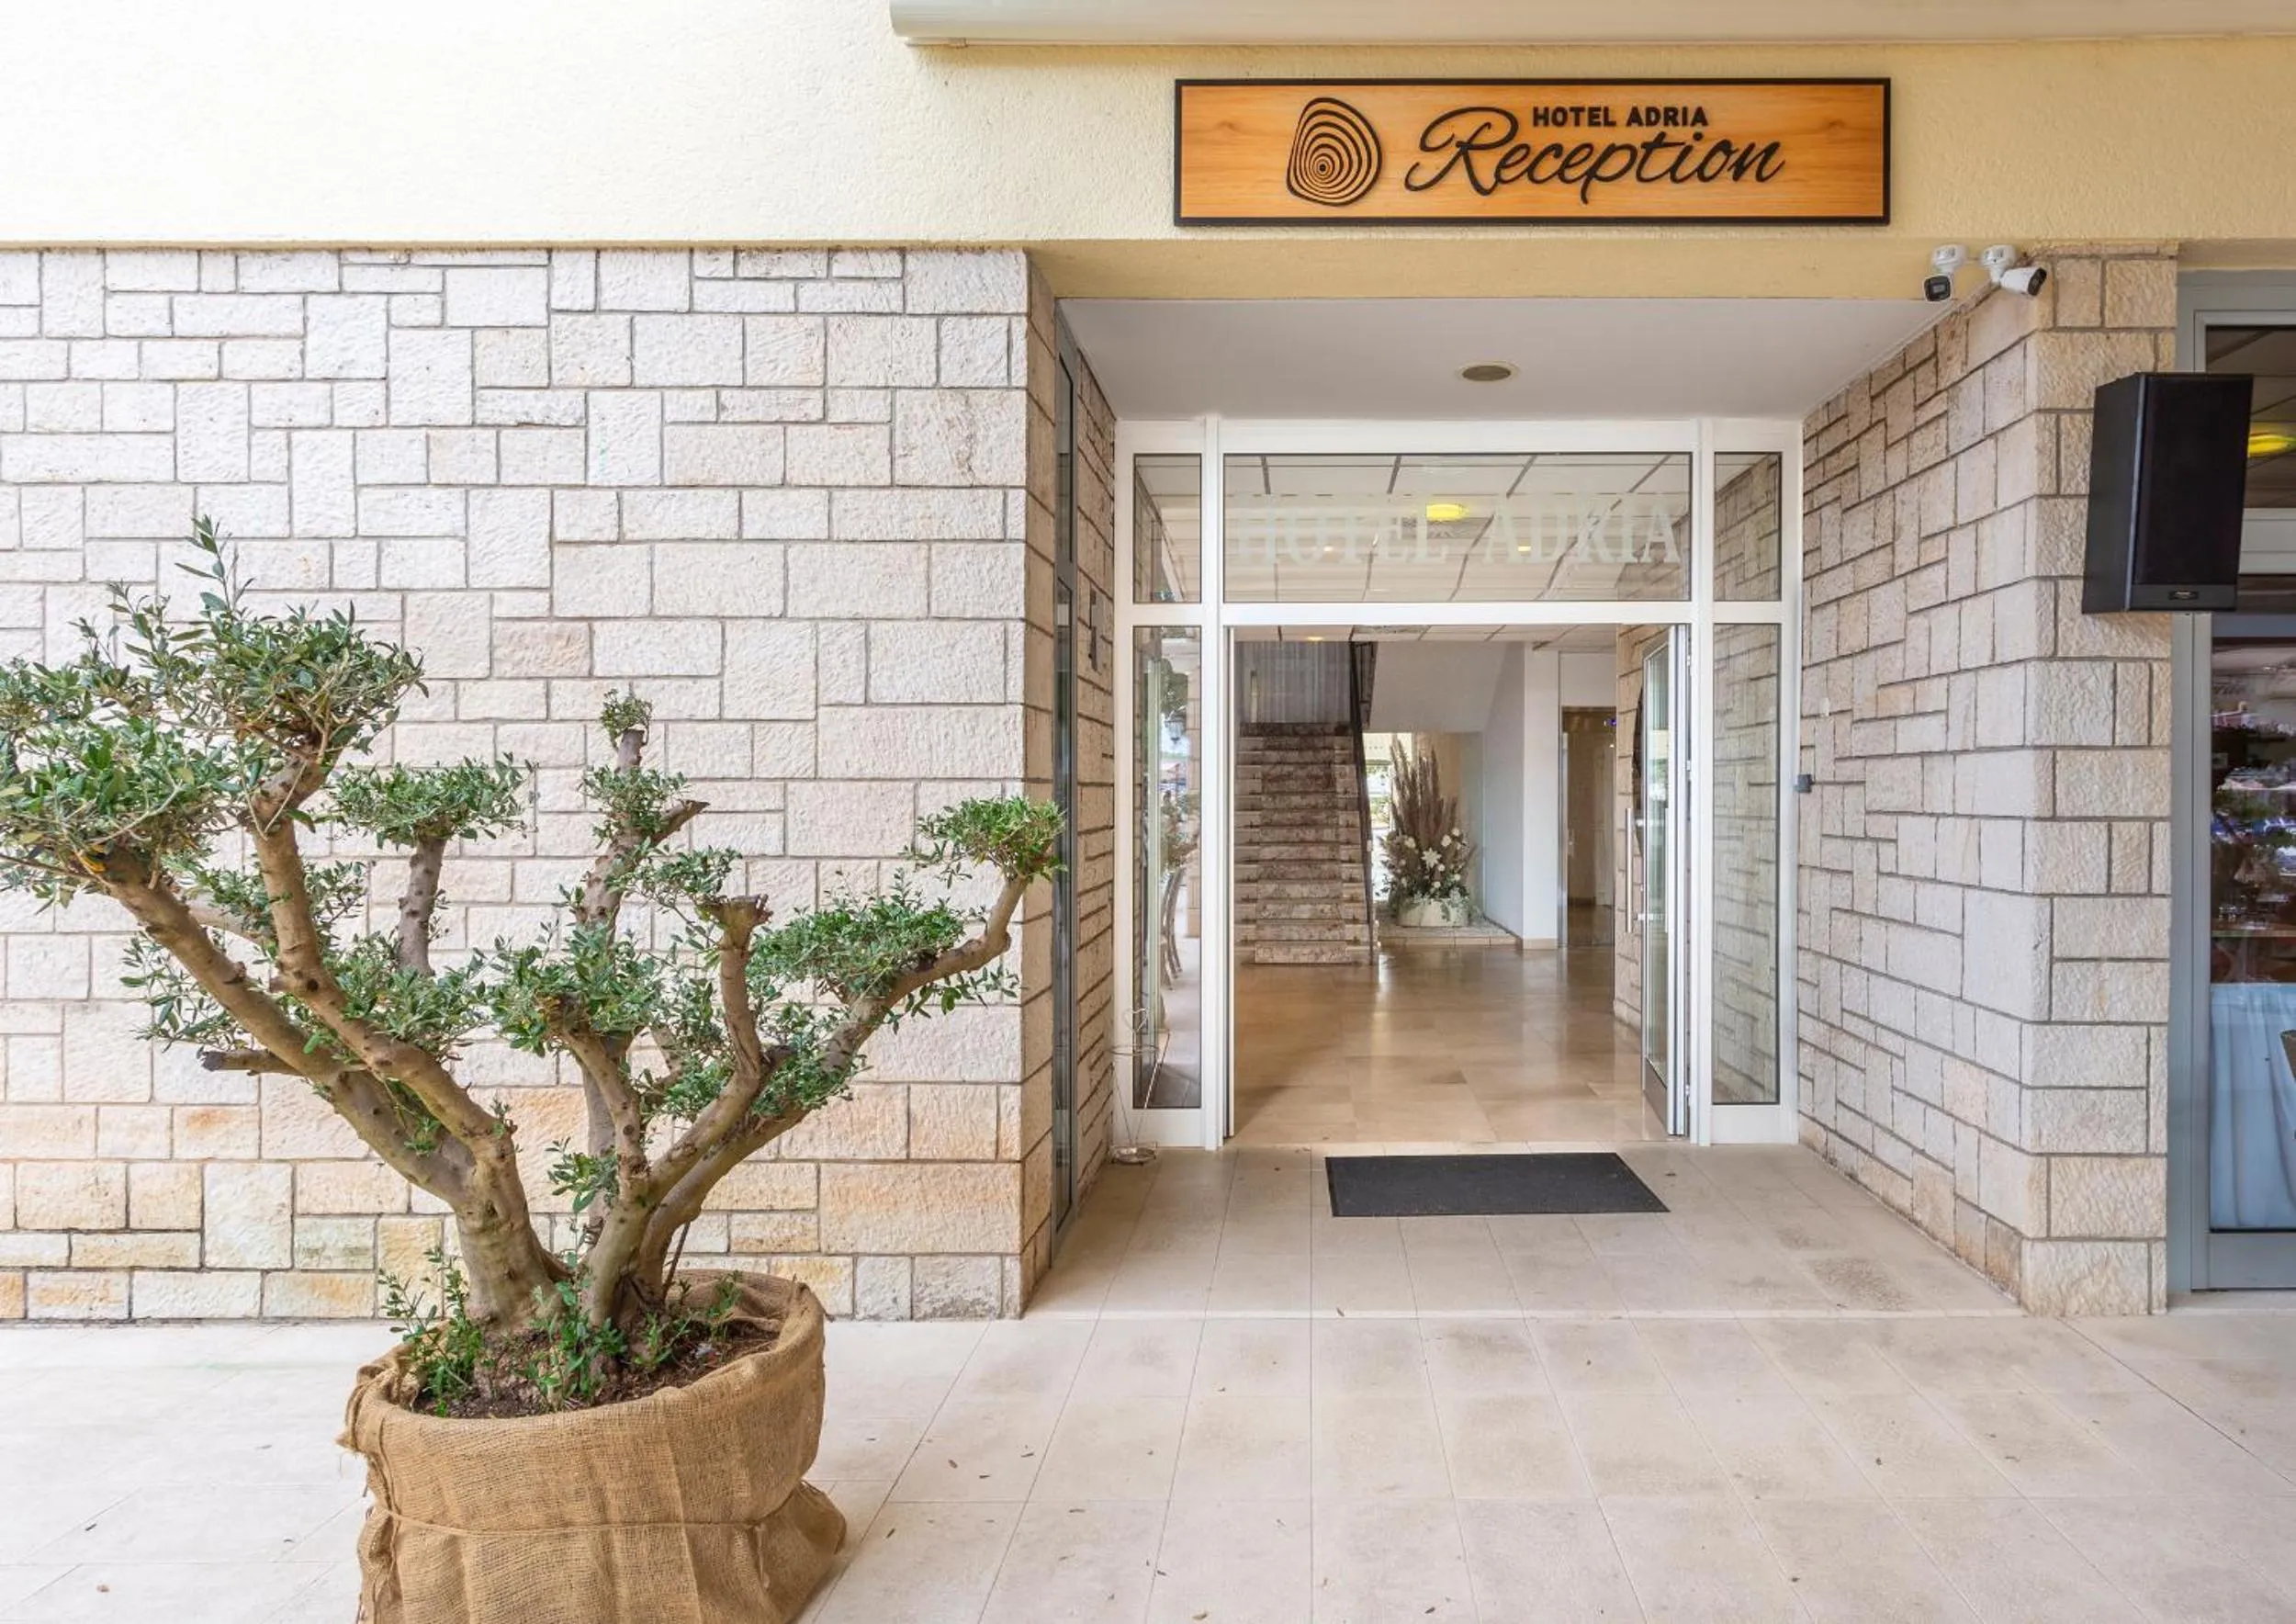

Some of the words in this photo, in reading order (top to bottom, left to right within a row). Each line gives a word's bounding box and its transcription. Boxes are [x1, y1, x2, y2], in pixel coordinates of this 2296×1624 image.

[1533, 107, 1617, 127] HOTEL
[1626, 107, 1709, 127] ADRIA
[1404, 107, 1786, 204] Reception
[1235, 492, 1450, 564] HOTEL
[1481, 492, 1681, 564] ADRIA
